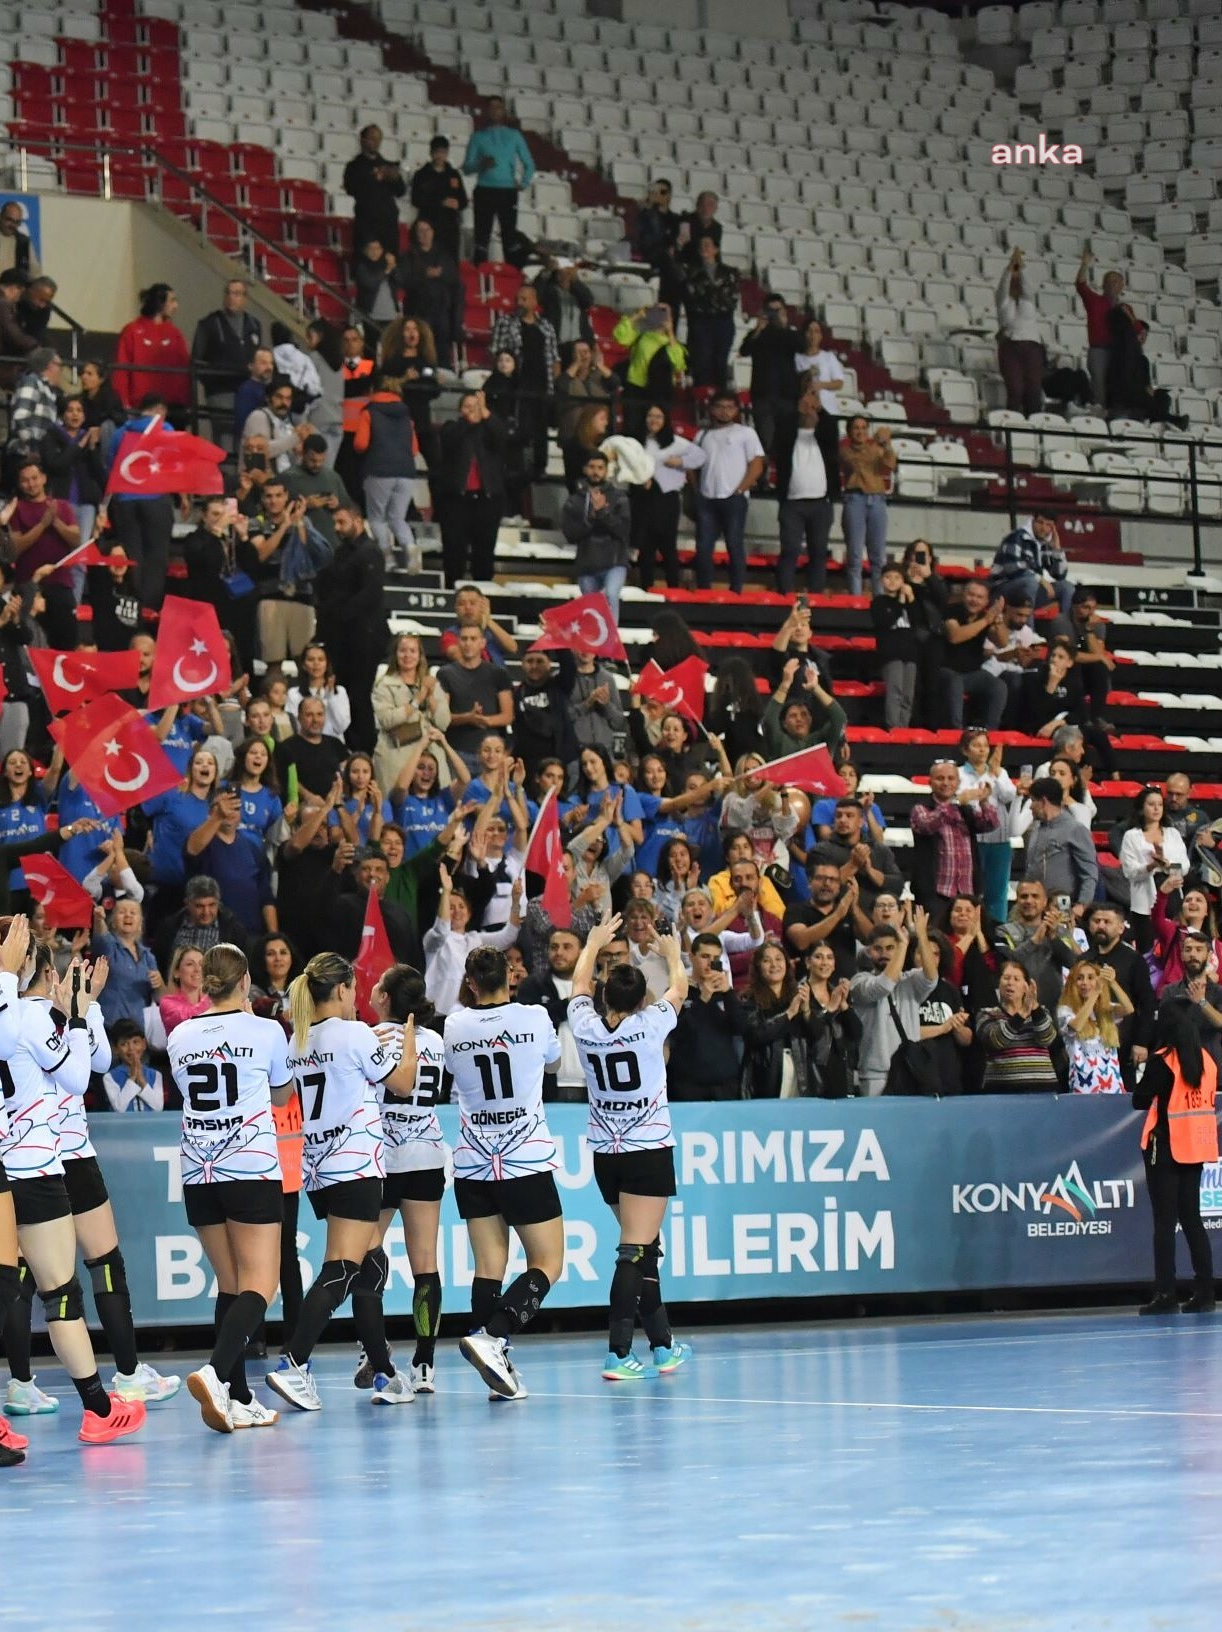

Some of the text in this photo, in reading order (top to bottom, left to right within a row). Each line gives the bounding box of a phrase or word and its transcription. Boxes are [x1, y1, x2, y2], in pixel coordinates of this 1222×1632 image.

[178, 1041, 254, 1066] KONYAALTI
[452, 1030, 534, 1053] KONYAALTI
[186, 1062, 239, 1111] 21
[383, 1065, 442, 1107] 3
[474, 1051, 514, 1100] 11
[587, 1051, 641, 1092] 10
[952, 1160, 1135, 1220] KONYAALTI
[1028, 1220, 1111, 1237] BELEDİYESİ
